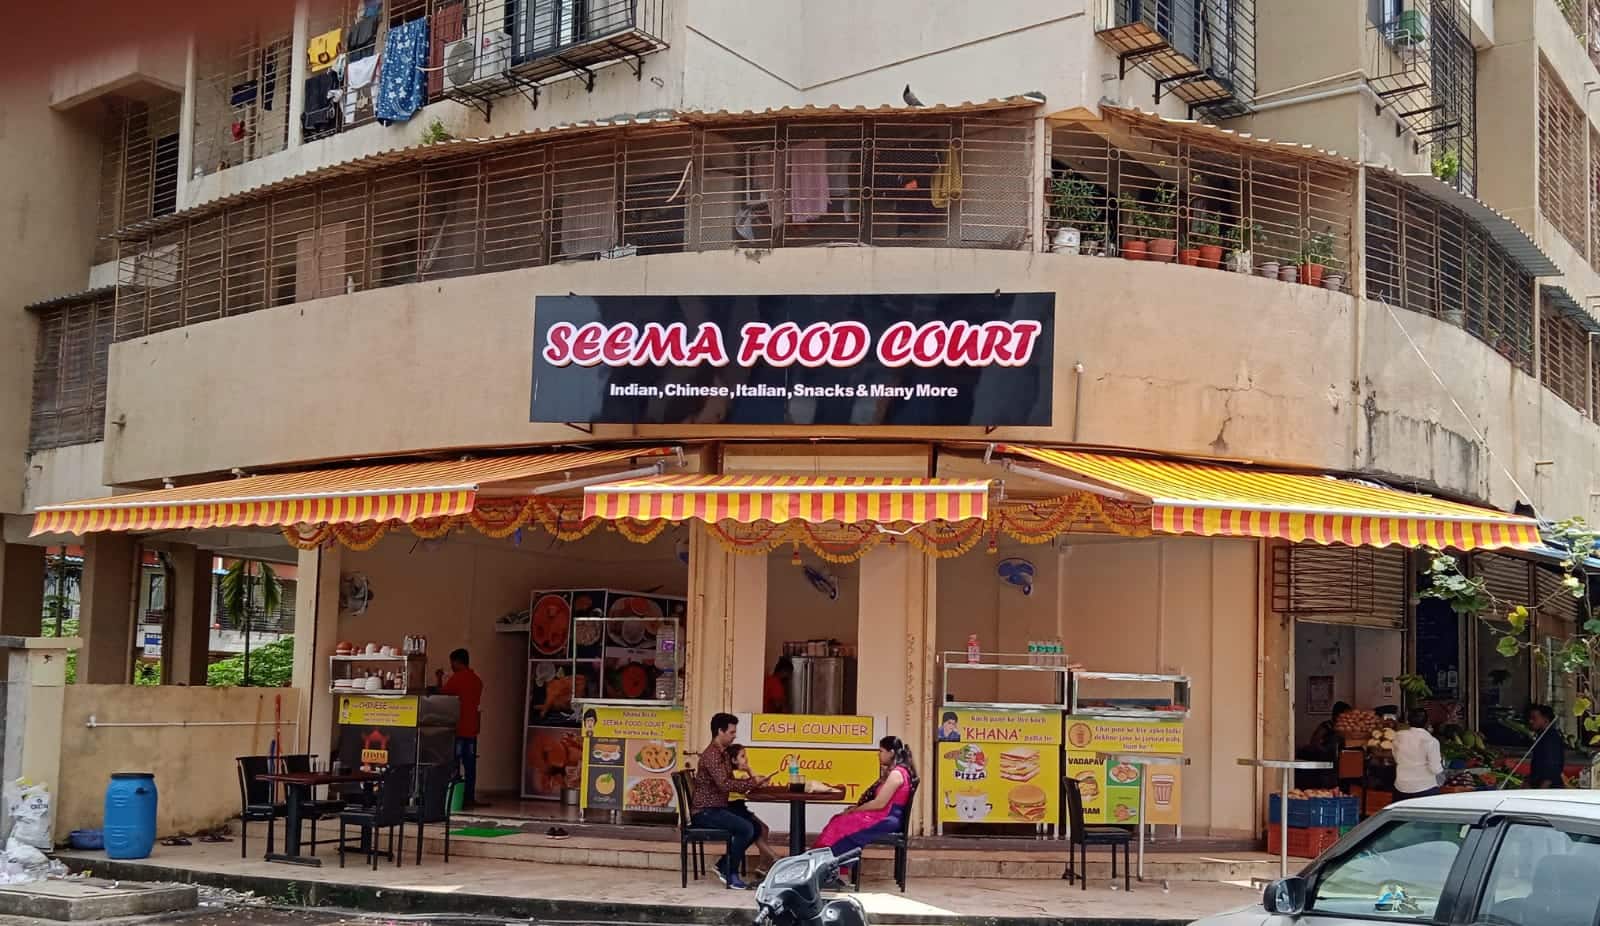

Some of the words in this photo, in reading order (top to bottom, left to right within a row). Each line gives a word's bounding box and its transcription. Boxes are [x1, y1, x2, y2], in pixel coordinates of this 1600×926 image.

[543, 321, 729, 367] SEEMA
[737, 321, 871, 367] FOOD
[877, 320, 1042, 367] COURT
[870, 384, 914, 400] Many
[916, 384, 958, 397] More
[759, 722, 796, 734] CASH
[802, 723, 868, 736] COUNTER
[780, 754, 833, 771] Please
[1068, 757, 1104, 766] VADAPAV
[955, 770, 985, 780] PIZZA
